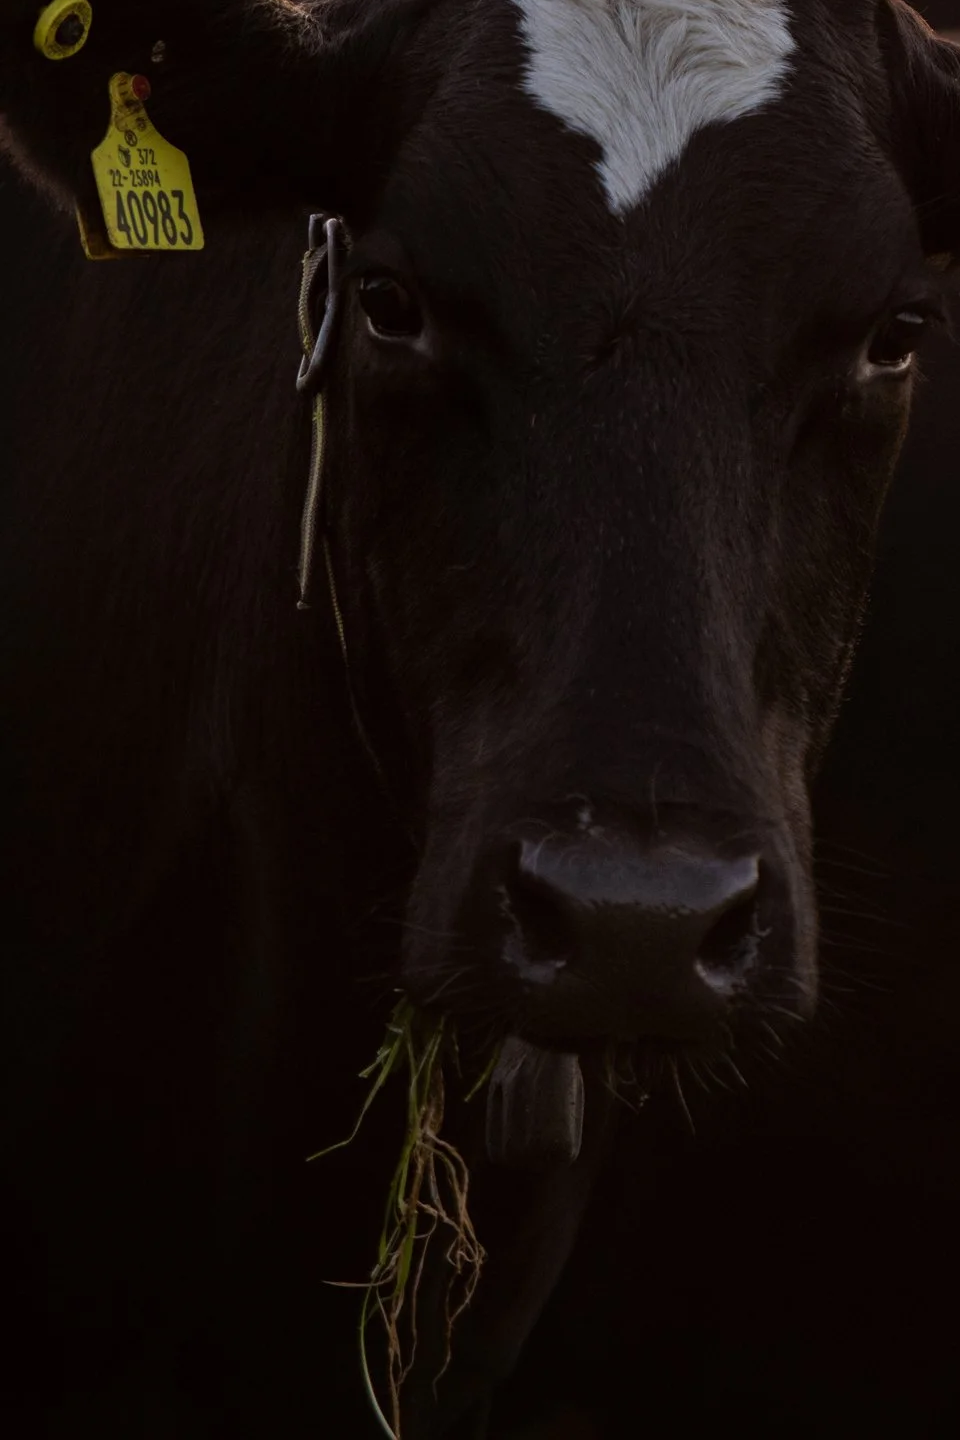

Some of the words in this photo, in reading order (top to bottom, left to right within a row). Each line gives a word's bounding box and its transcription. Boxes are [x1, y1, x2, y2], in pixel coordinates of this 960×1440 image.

[137, 149, 158, 165] 372
[110, 169, 162, 187] 22-25894
[116, 190, 193, 245] 40983
